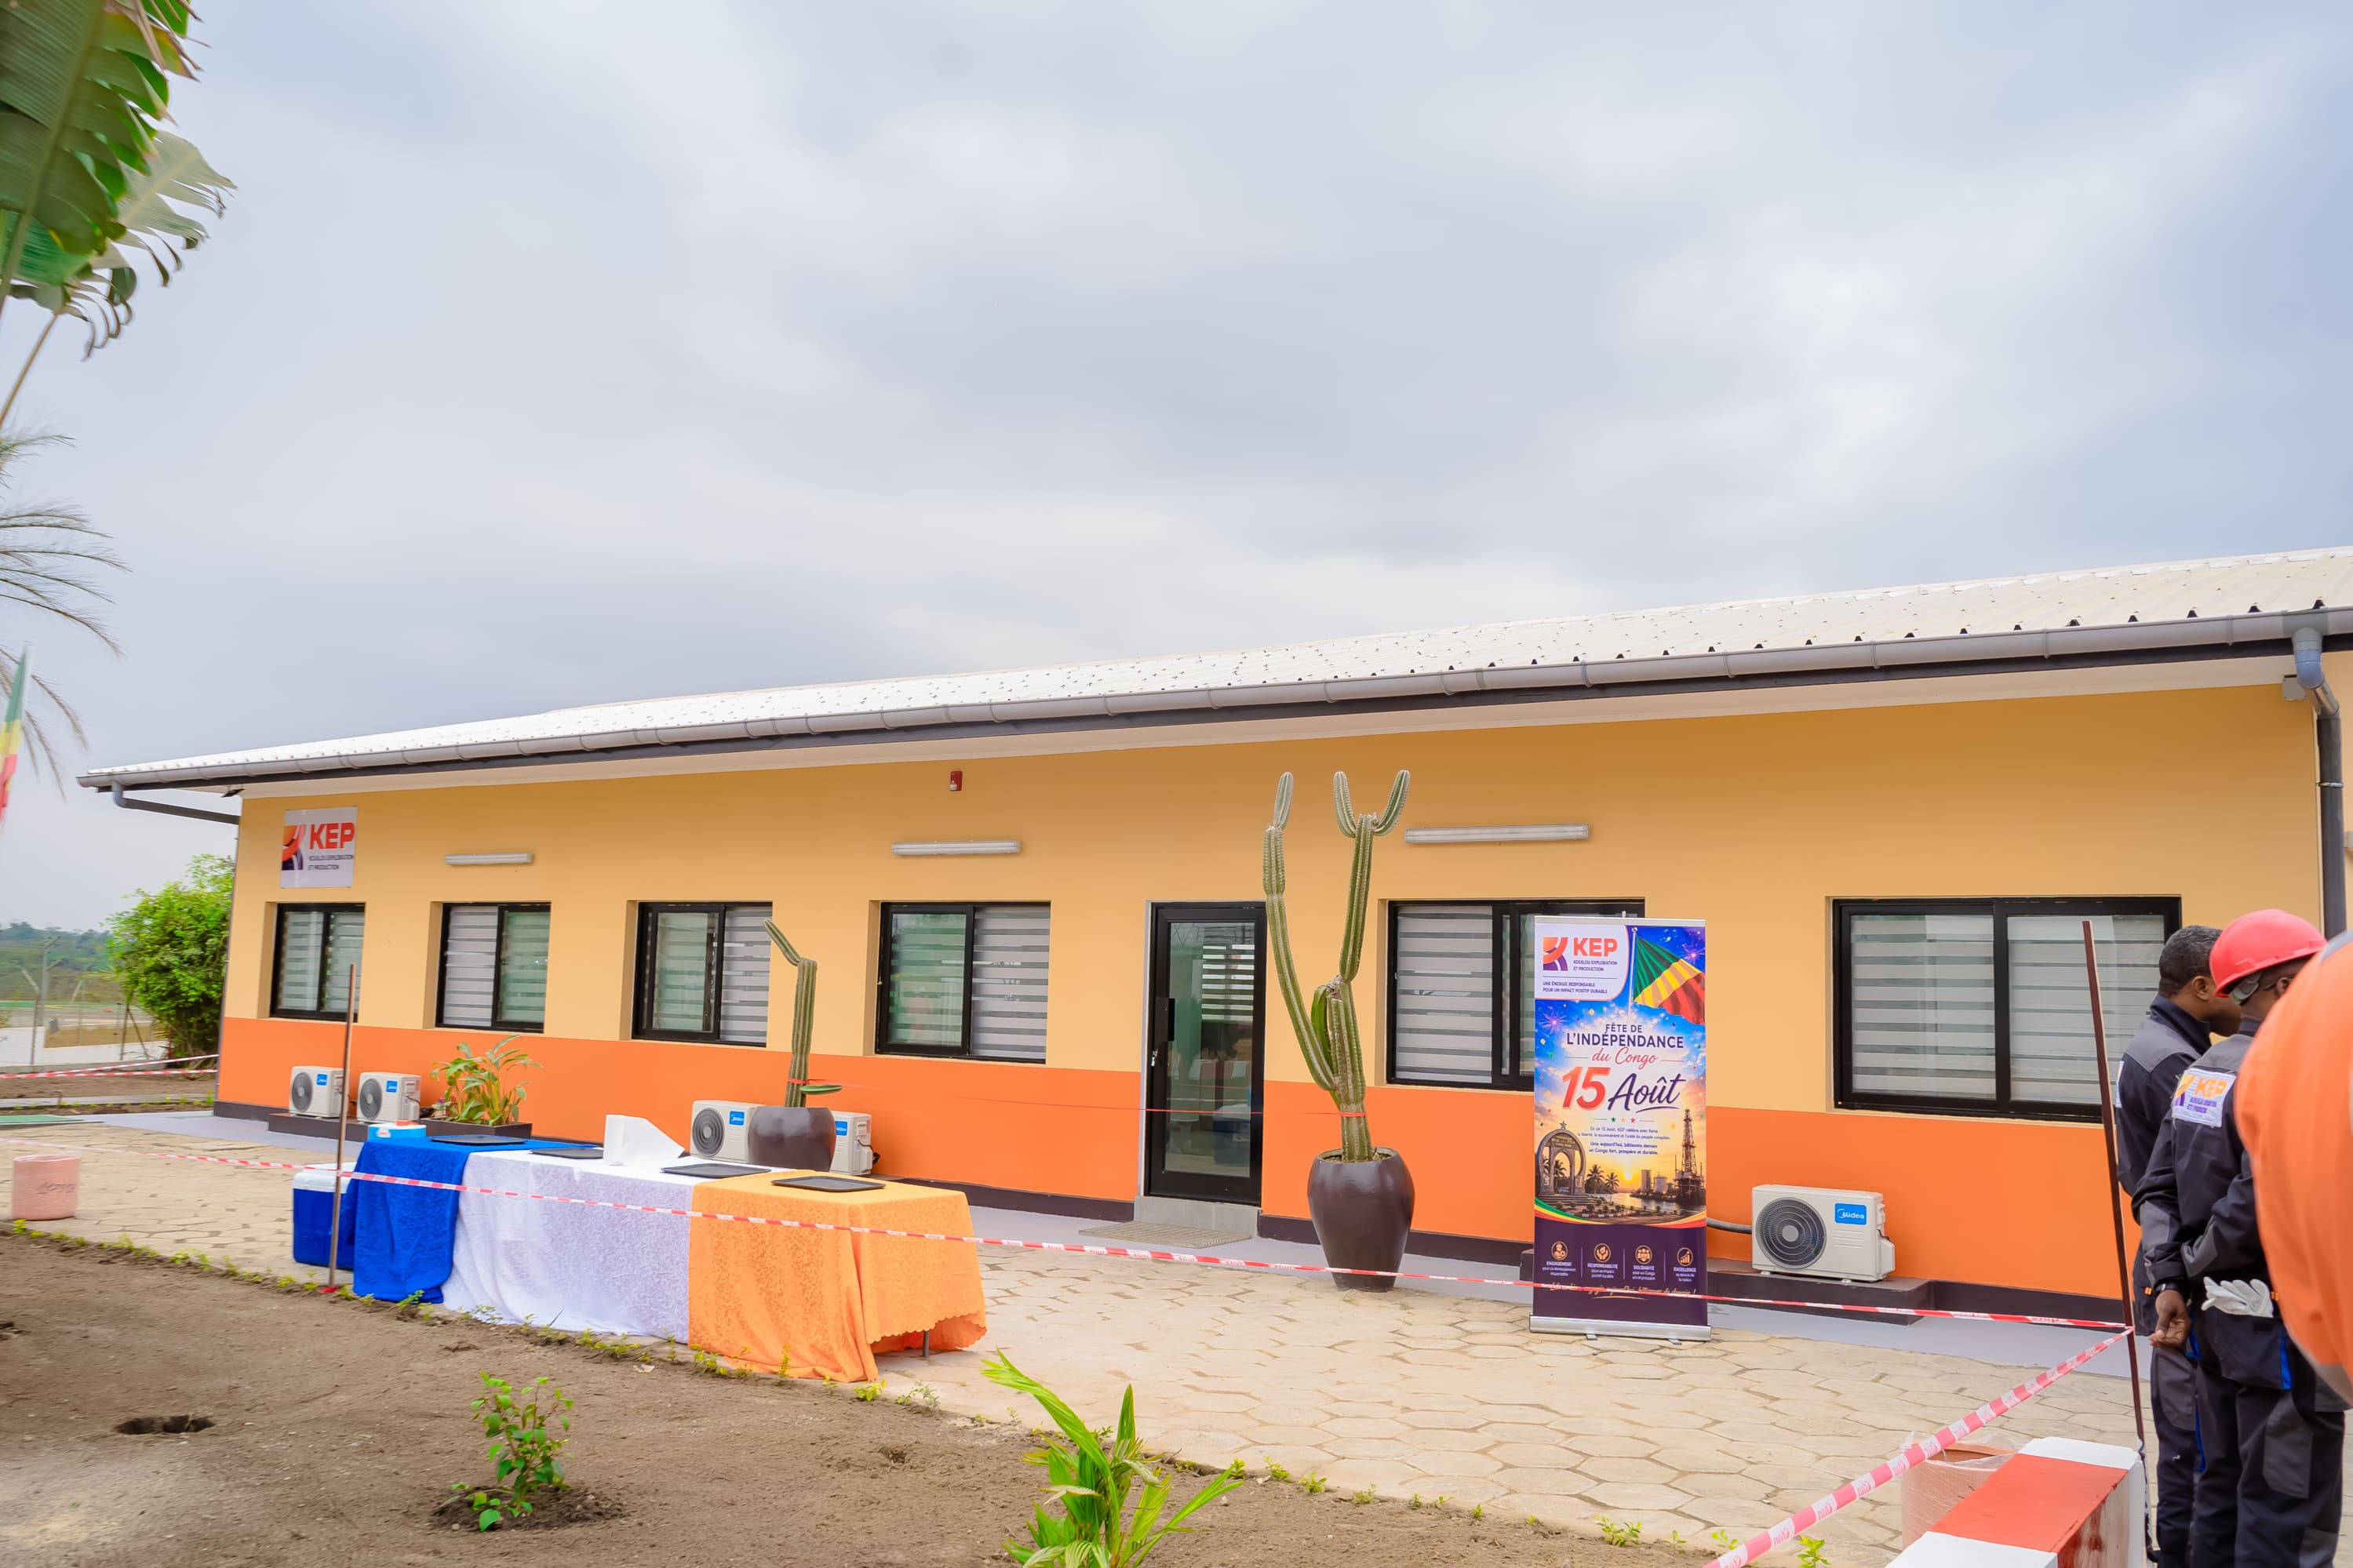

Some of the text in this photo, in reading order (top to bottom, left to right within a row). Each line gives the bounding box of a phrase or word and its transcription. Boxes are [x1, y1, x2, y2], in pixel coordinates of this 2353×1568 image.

[309, 822, 355, 849] KEP
[1573, 937, 1618, 957] KEP
[1605, 1022, 1643, 1033] FÊTE DE
[1567, 1031, 1684, 1049] L'INDÉPENDANCE
[1591, 1046, 1658, 1070] du Congo
[1561, 1066, 1686, 1111] 15 Août
[2194, 1076, 2227, 1098] KEP
[1838, 1209, 1865, 1219] Midea
